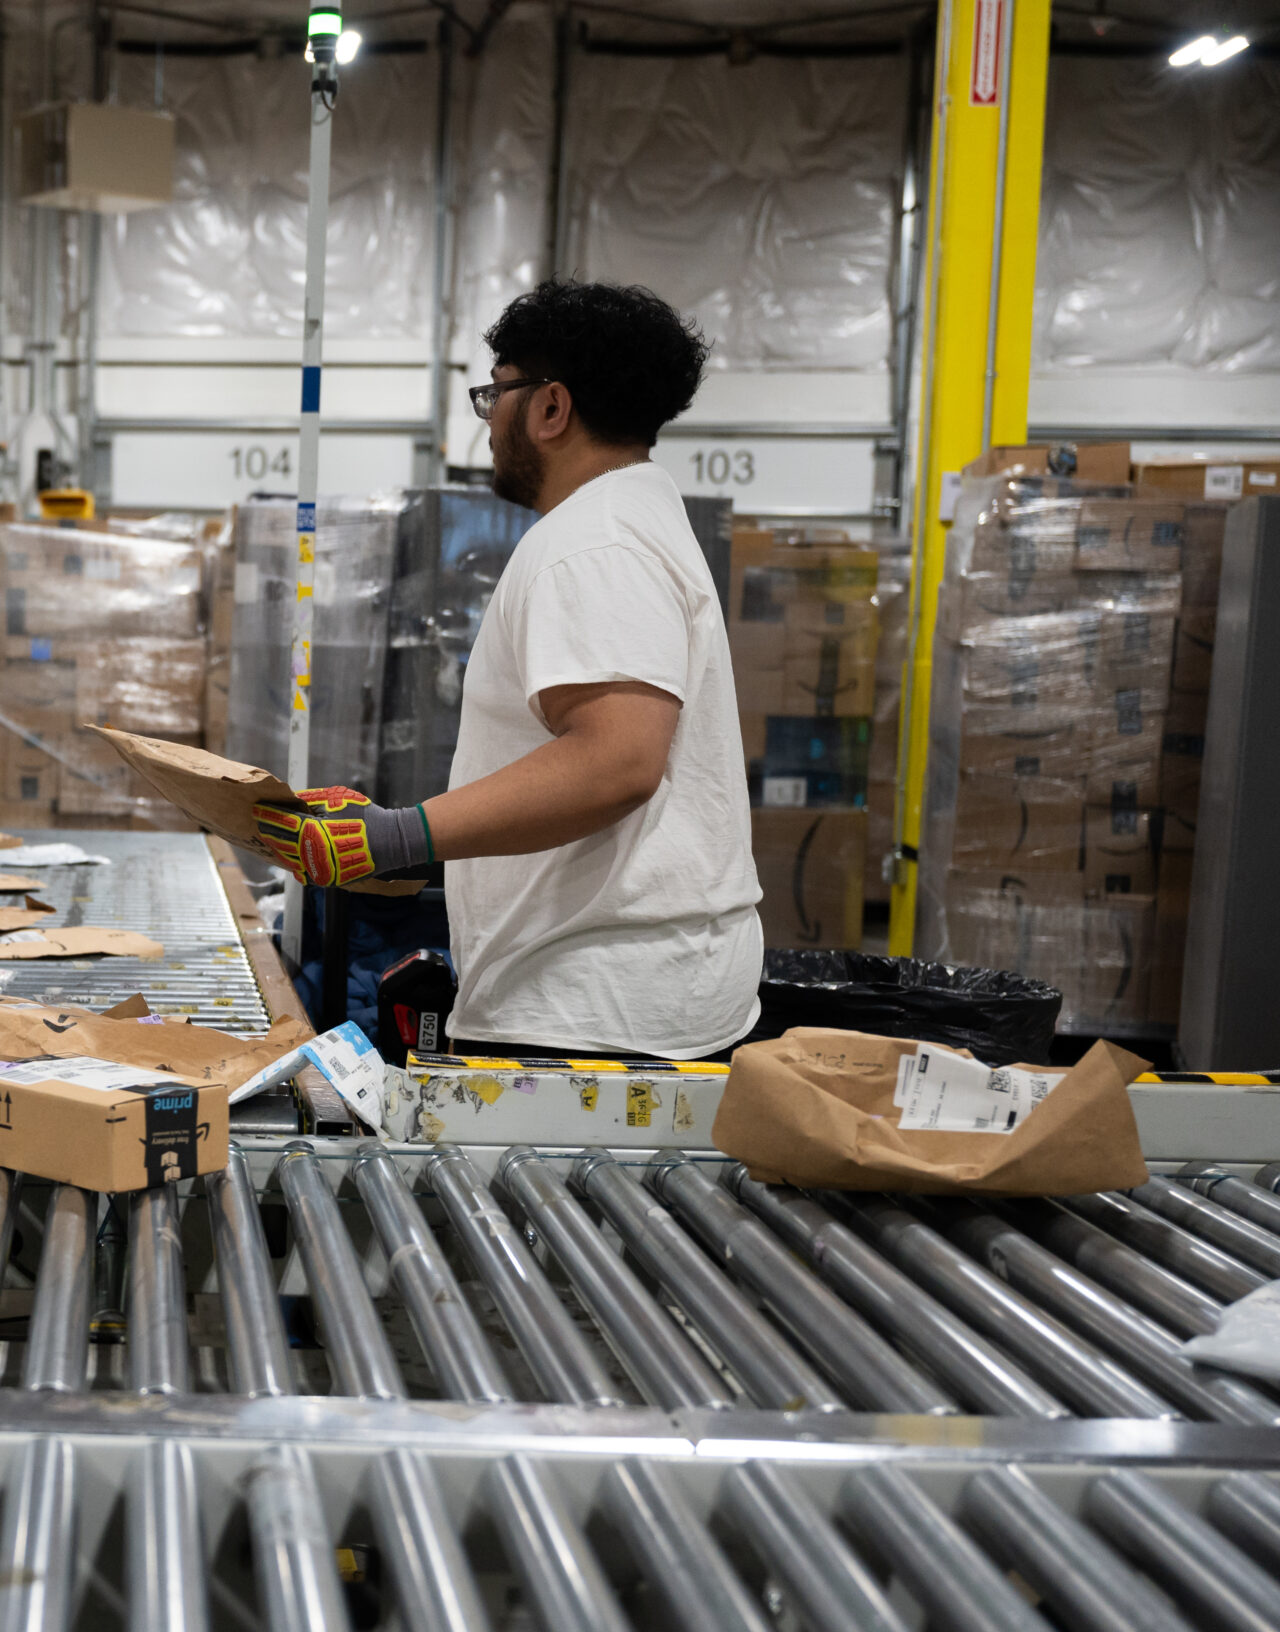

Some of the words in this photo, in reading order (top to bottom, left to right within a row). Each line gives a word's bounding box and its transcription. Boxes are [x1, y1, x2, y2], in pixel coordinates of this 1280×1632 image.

[228, 446, 292, 479] 104
[690, 450, 755, 484] 103
[422, 1014, 436, 1046] 6750
[153, 1091, 193, 1114] prime
[631, 1087, 647, 1098] A
